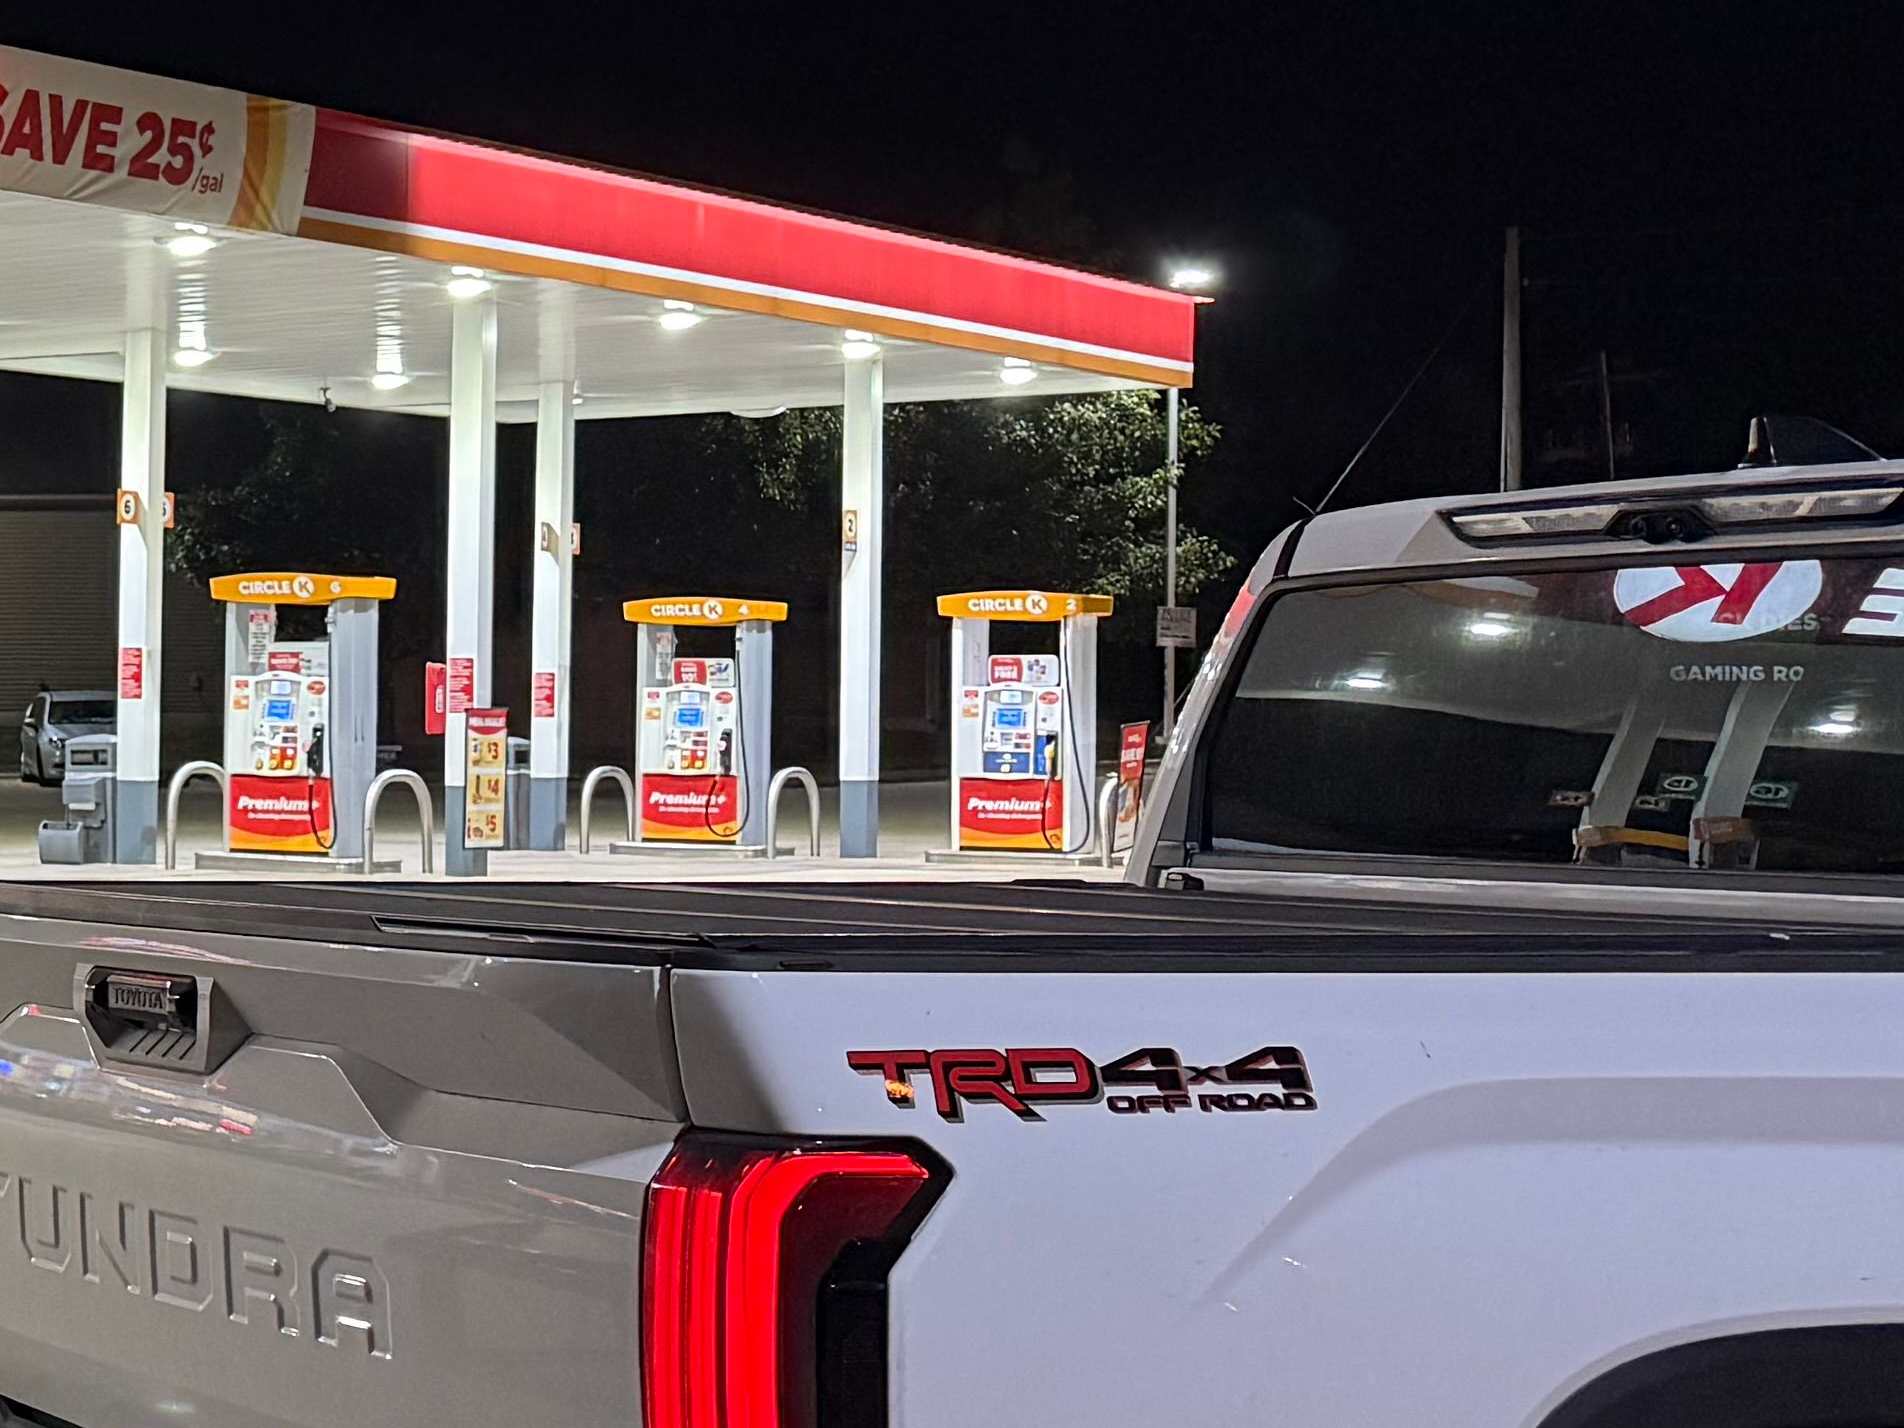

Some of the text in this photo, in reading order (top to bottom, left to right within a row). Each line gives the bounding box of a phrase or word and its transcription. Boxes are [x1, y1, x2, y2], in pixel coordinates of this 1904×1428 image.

[128, 112, 215, 186] 25¢
[124, 500, 131, 515] 6
[239, 581, 292, 594] CIRCLE
[296, 579, 313, 596] K
[651, 604, 701, 617] CIRCLE
[705, 603, 721, 618] K
[968, 598, 1023, 612] CIRCLE
[1028, 597, 1044, 613] K
[1669, 665, 1766, 682] GAMING
[112, 988, 164, 1010] TOYOTA
[847, 1048, 1102, 1123] TRD
[1106, 1092, 1317, 1114] OFF ROAD
